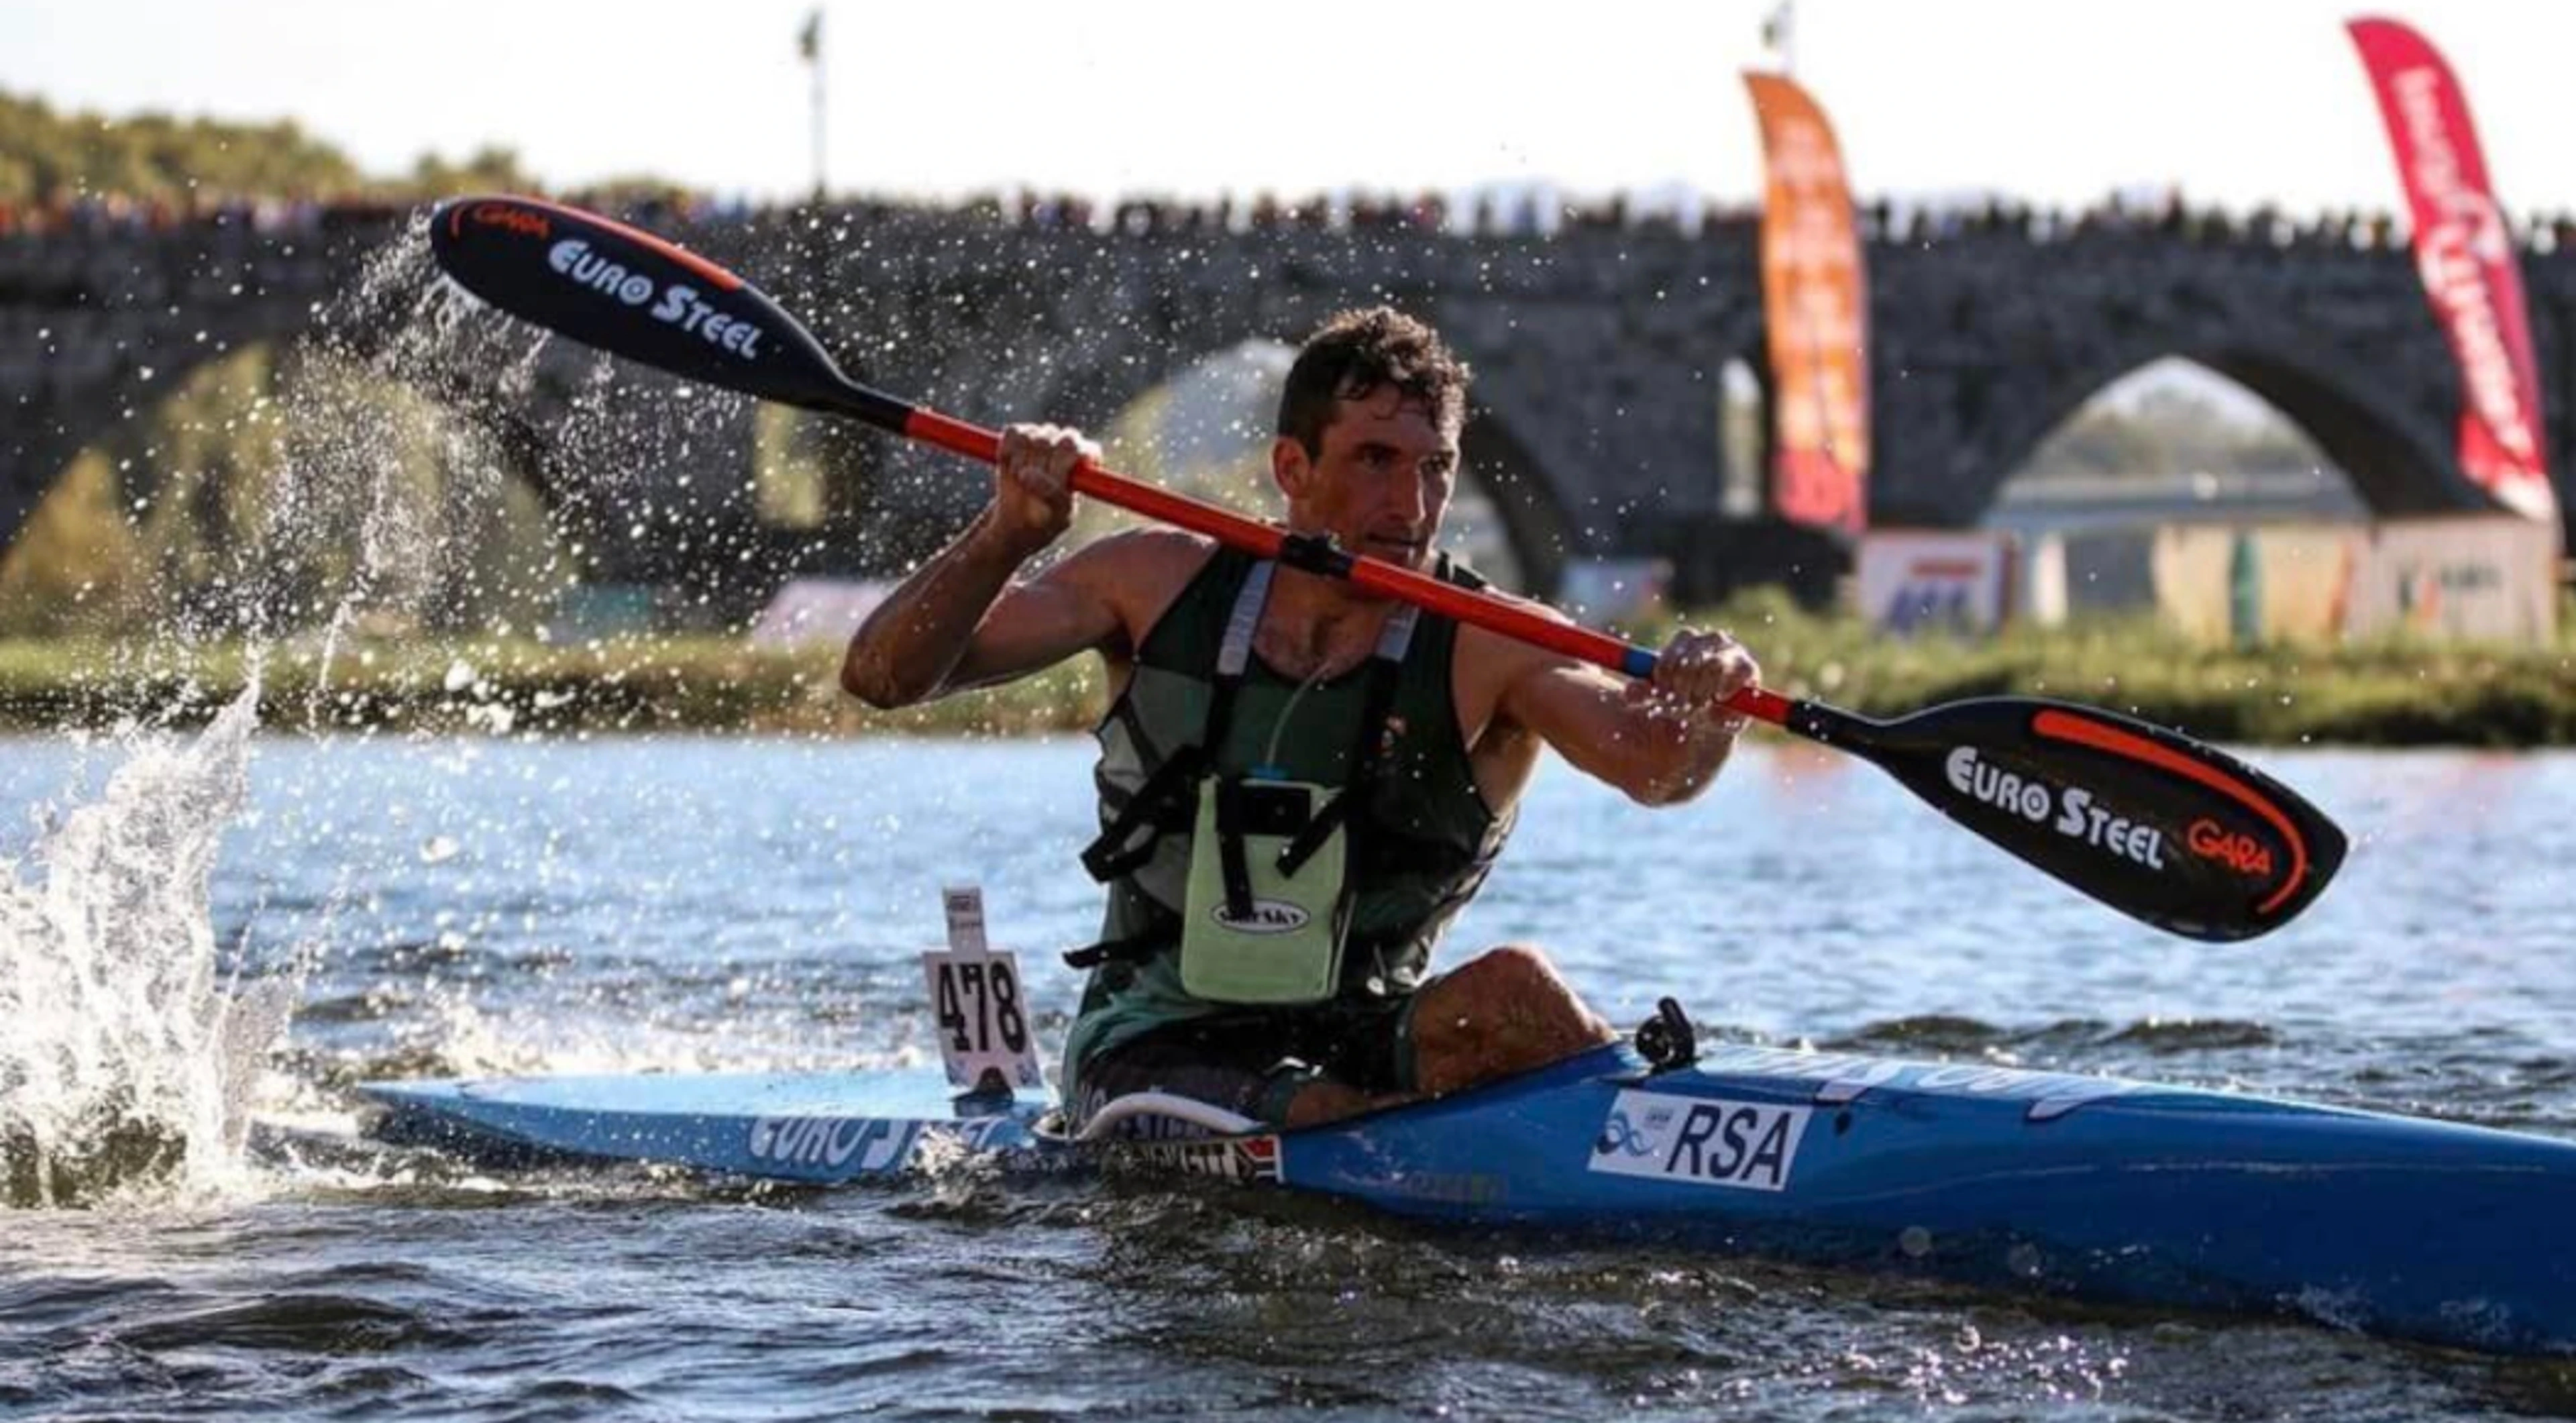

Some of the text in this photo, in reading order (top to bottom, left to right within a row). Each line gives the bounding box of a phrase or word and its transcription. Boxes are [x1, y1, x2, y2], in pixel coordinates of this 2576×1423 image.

[549, 239, 765, 360] EURO STEEL
[1945, 745, 2164, 870] EURO STEEL
[2187, 819, 2272, 876] GARA
[938, 961, 1027, 1054] 478
[1664, 1104, 1792, 1185] RSA
